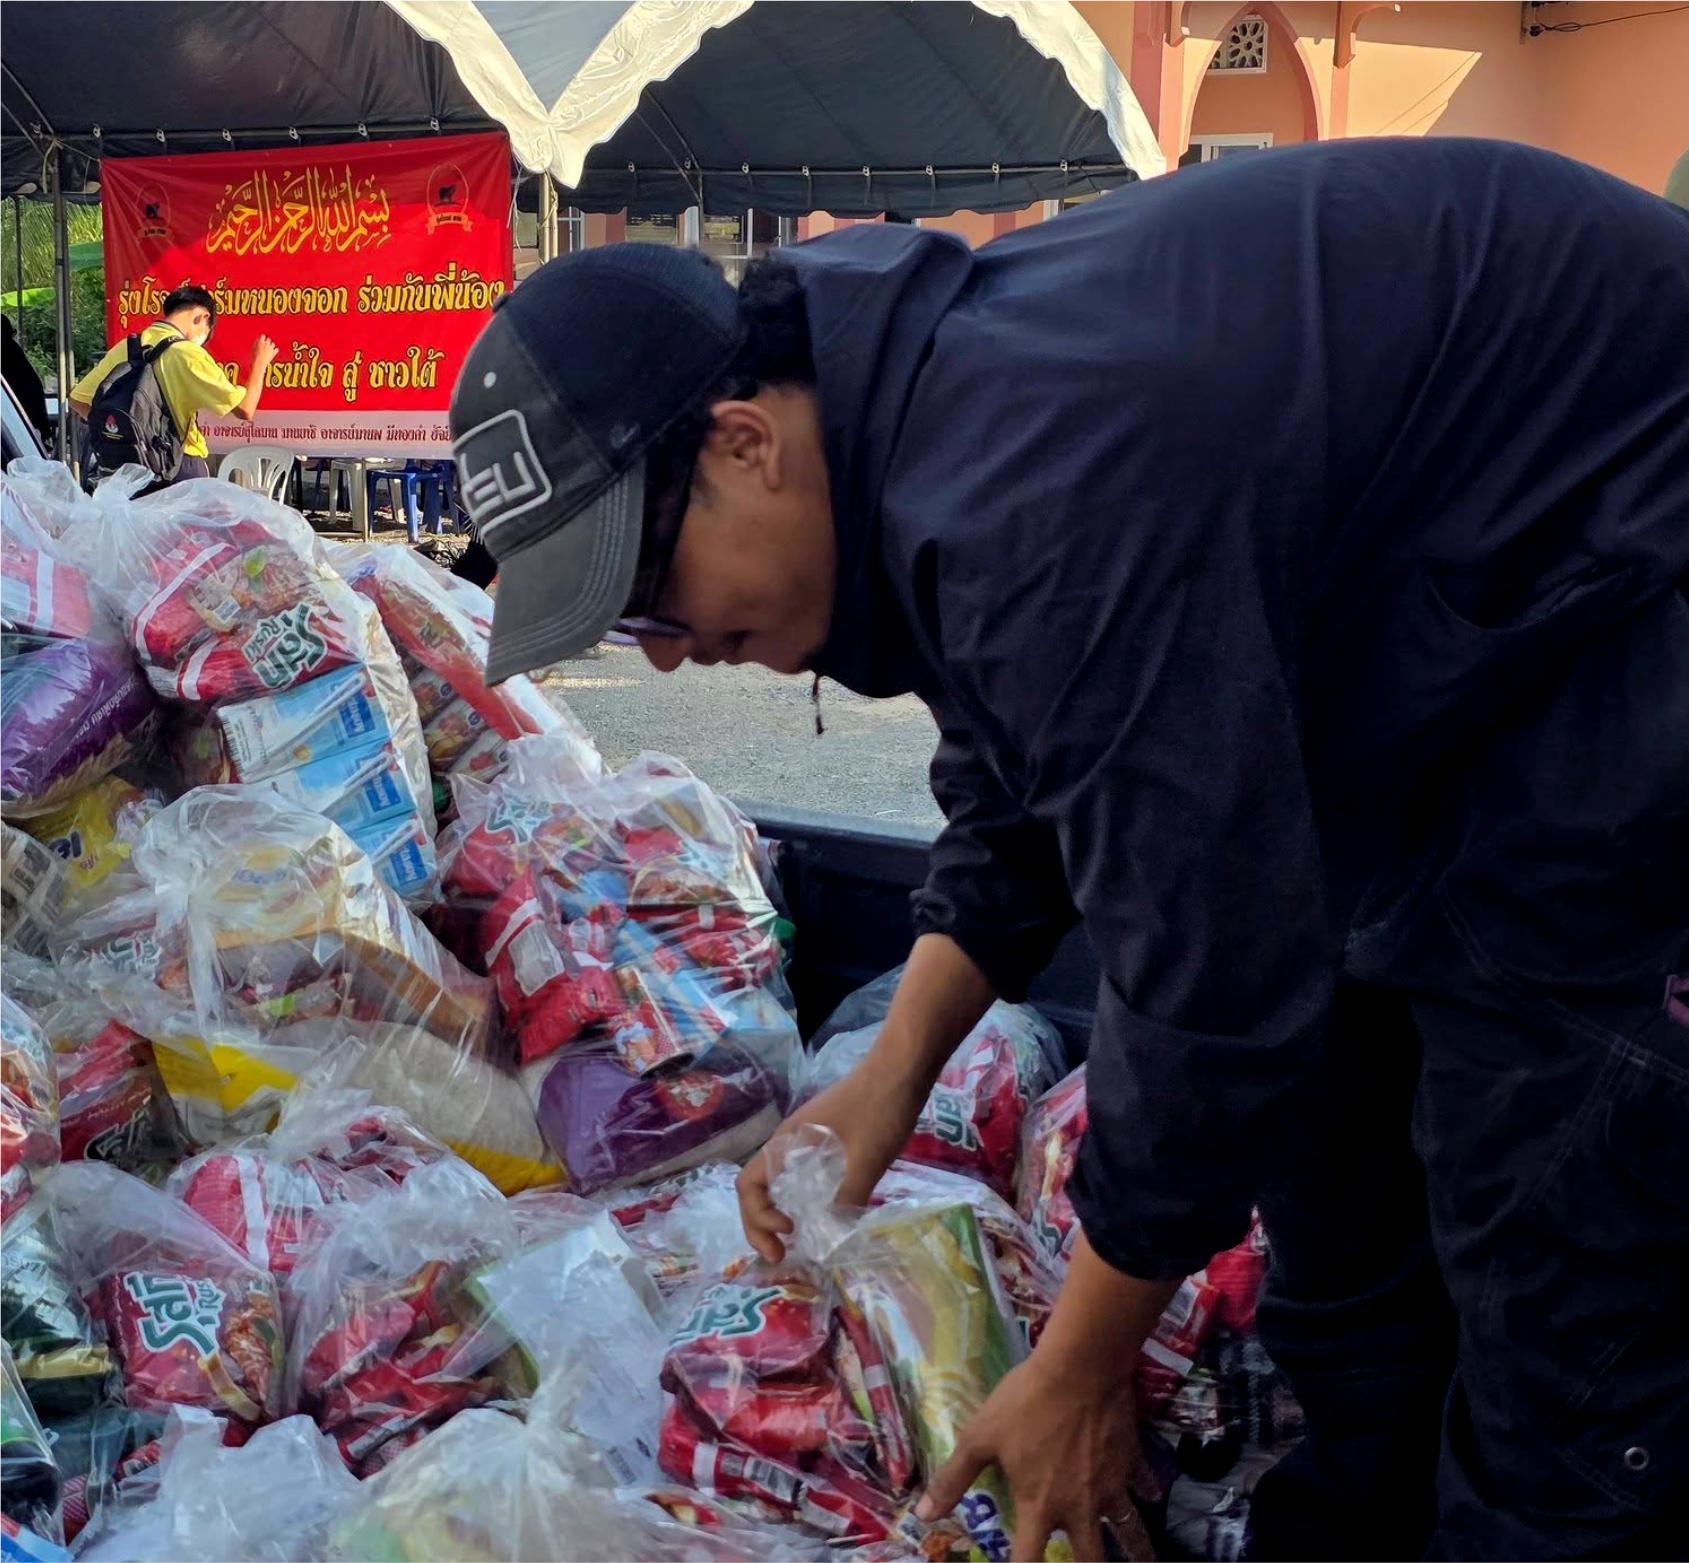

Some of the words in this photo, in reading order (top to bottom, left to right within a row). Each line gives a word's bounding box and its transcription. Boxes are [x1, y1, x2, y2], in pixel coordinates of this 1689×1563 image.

[264, 341, 335, 388] ารน้ำใจ
[342, 351, 363, 402] สู่
[369, 346, 445, 389] ชาวใต้
